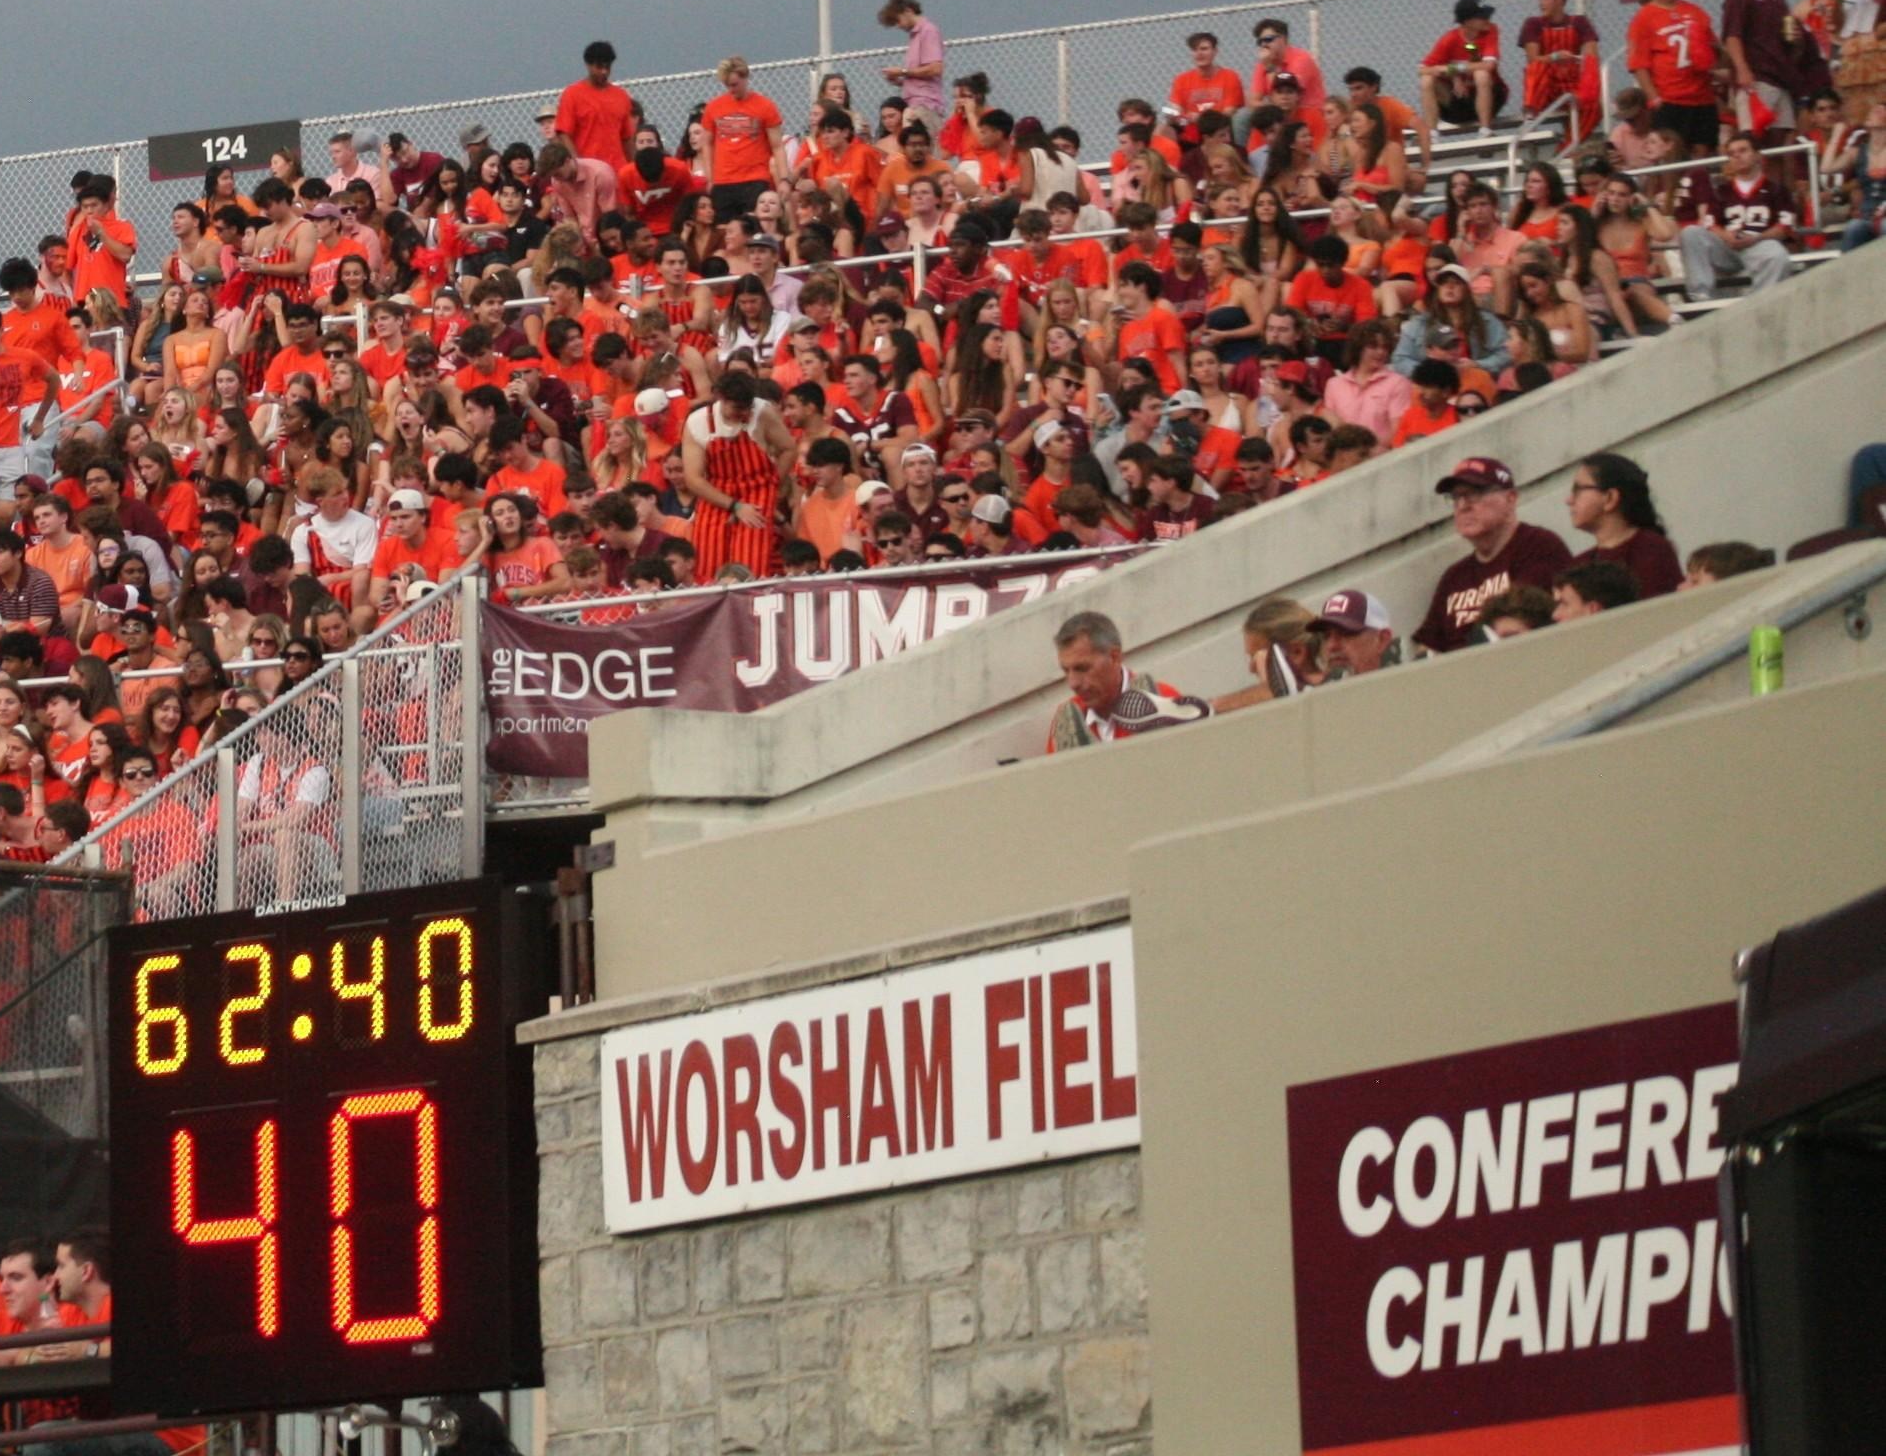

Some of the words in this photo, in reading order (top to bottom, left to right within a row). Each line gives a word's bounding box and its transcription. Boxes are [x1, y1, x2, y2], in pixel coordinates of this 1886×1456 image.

[202, 134, 248, 163] 124
[1446, 571, 1511, 616] VIRGNIA
[487, 647, 512, 697] the
[513, 646, 678, 701] EDGE
[495, 713, 588, 737] partmen
[255, 894, 347, 918] DAKTRONICS
[136, 917, 473, 1076] 62:40
[615, 992, 955, 1204] WORSHAM
[984, 962, 1137, 1142] FIEL
[1337, 1062, 1741, 1238] CONFERE
[171, 1088, 440, 1344] 40
[1366, 1218, 1734, 1379] CHAMPI
